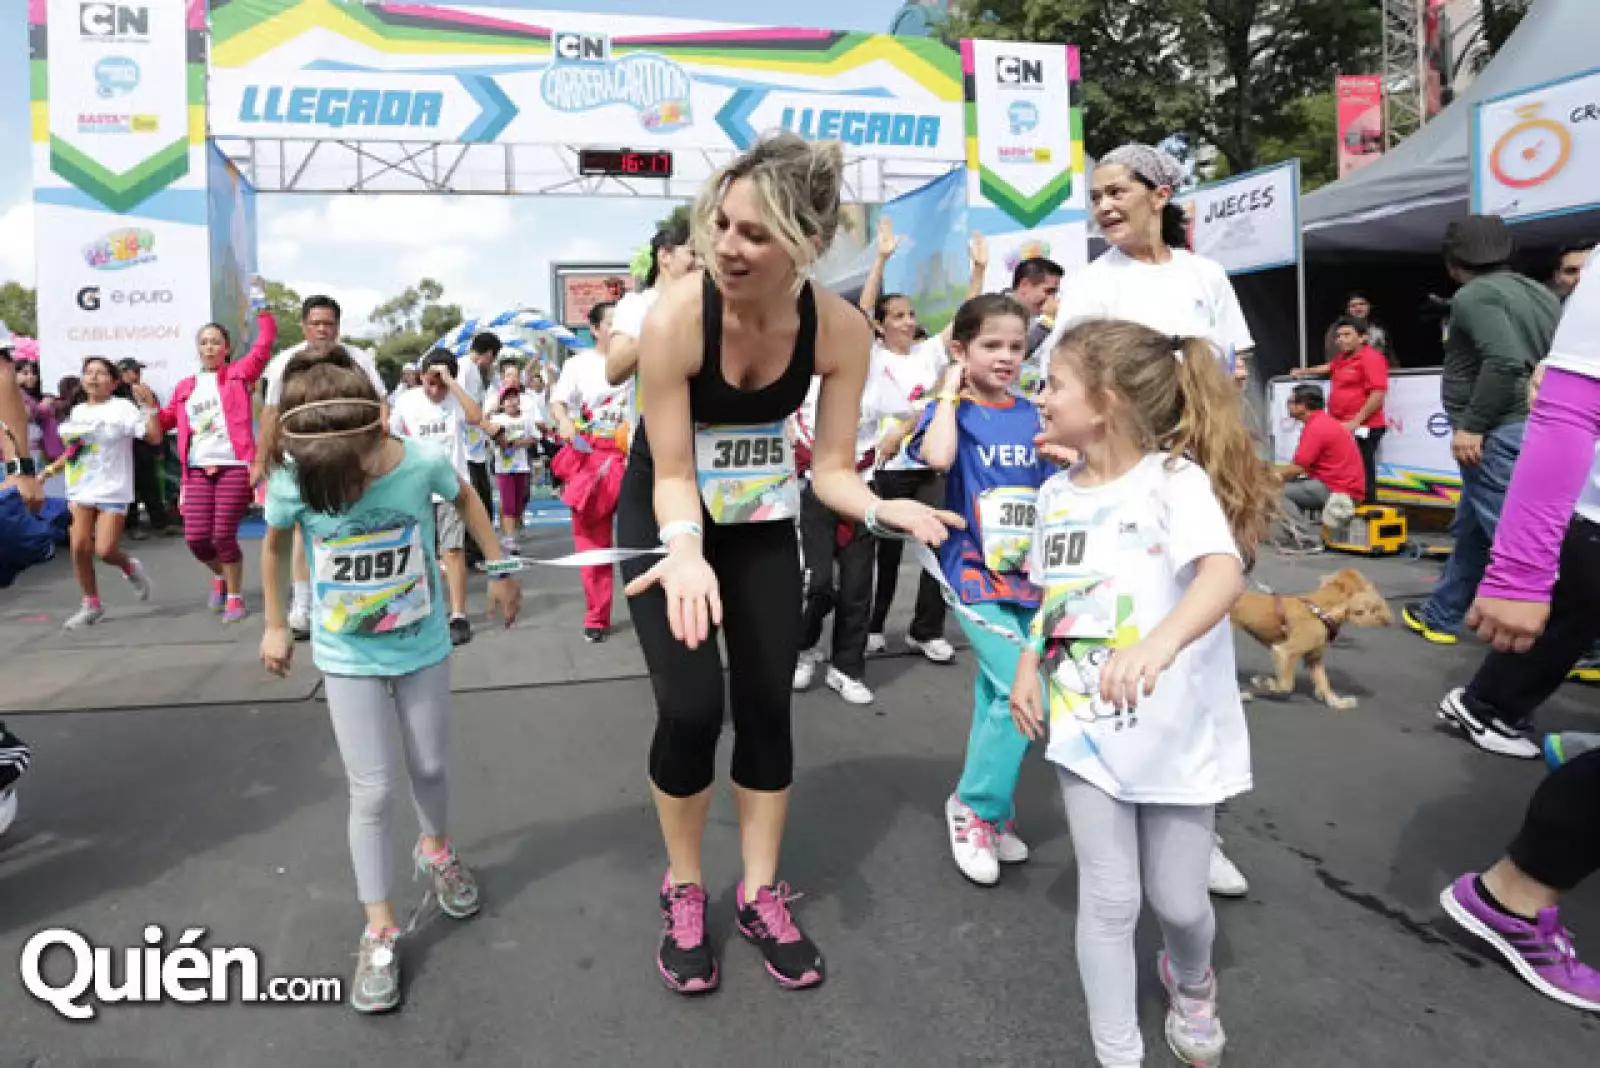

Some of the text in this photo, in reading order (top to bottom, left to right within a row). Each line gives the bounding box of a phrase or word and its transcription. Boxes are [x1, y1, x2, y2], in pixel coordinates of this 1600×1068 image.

[80, 4, 149, 35] CN
[553, 34, 605, 60] CN
[996, 56, 1044, 84] CN
[238, 84, 444, 128] LLEGADA
[1569, 103, 1600, 124] CR
[1204, 185, 1275, 223] JUECES
[76, 286, 101, 311] G
[713, 437, 784, 469] 3095
[332, 545, 412, 581] 2097
